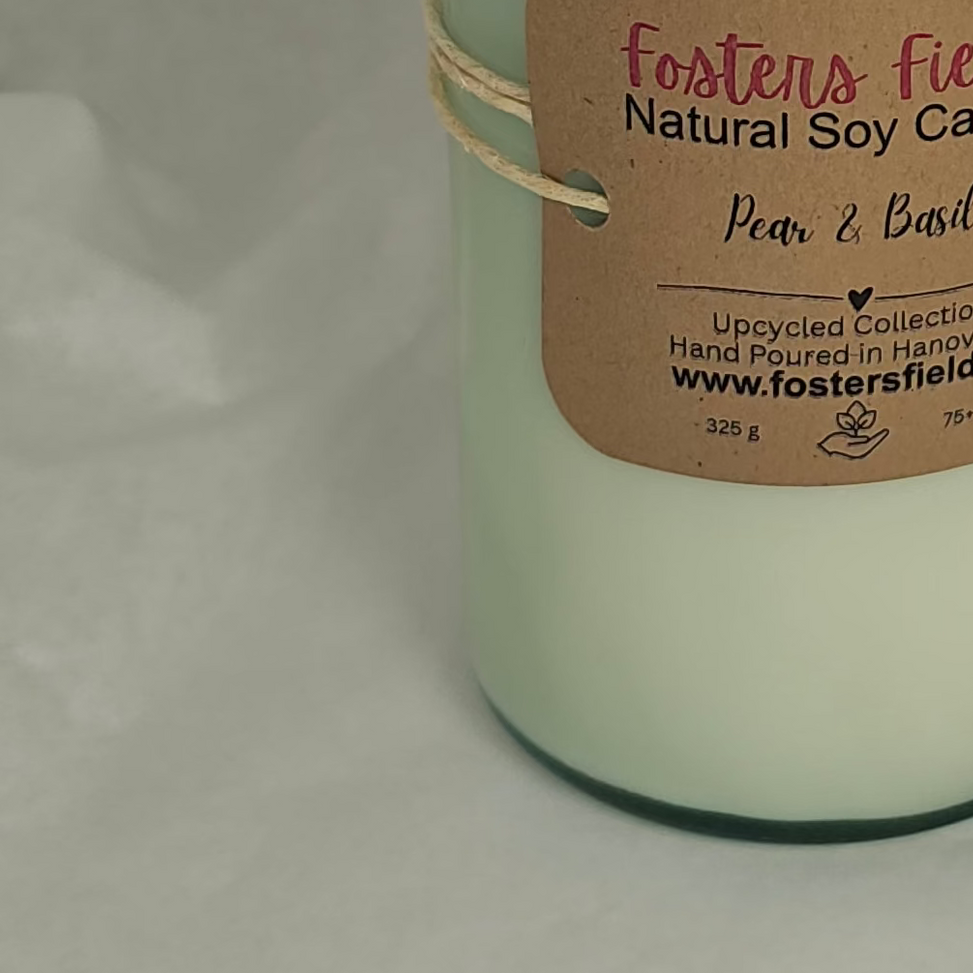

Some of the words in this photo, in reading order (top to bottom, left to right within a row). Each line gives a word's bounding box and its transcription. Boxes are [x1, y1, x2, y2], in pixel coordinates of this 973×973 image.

[620, 21, 868, 110] Fosters
[624, 94, 789, 150] Natural
[808, 108, 898, 158] Soy
[723, 192, 813, 244] Pear
[835, 202, 862, 244] &
[712, 312, 845, 343] Upcycled
[669, 335, 740, 365] Hand
[749, 343, 851, 367] Poured
[705, 418, 742, 438] 325
[747, 423, 760, 442] g
